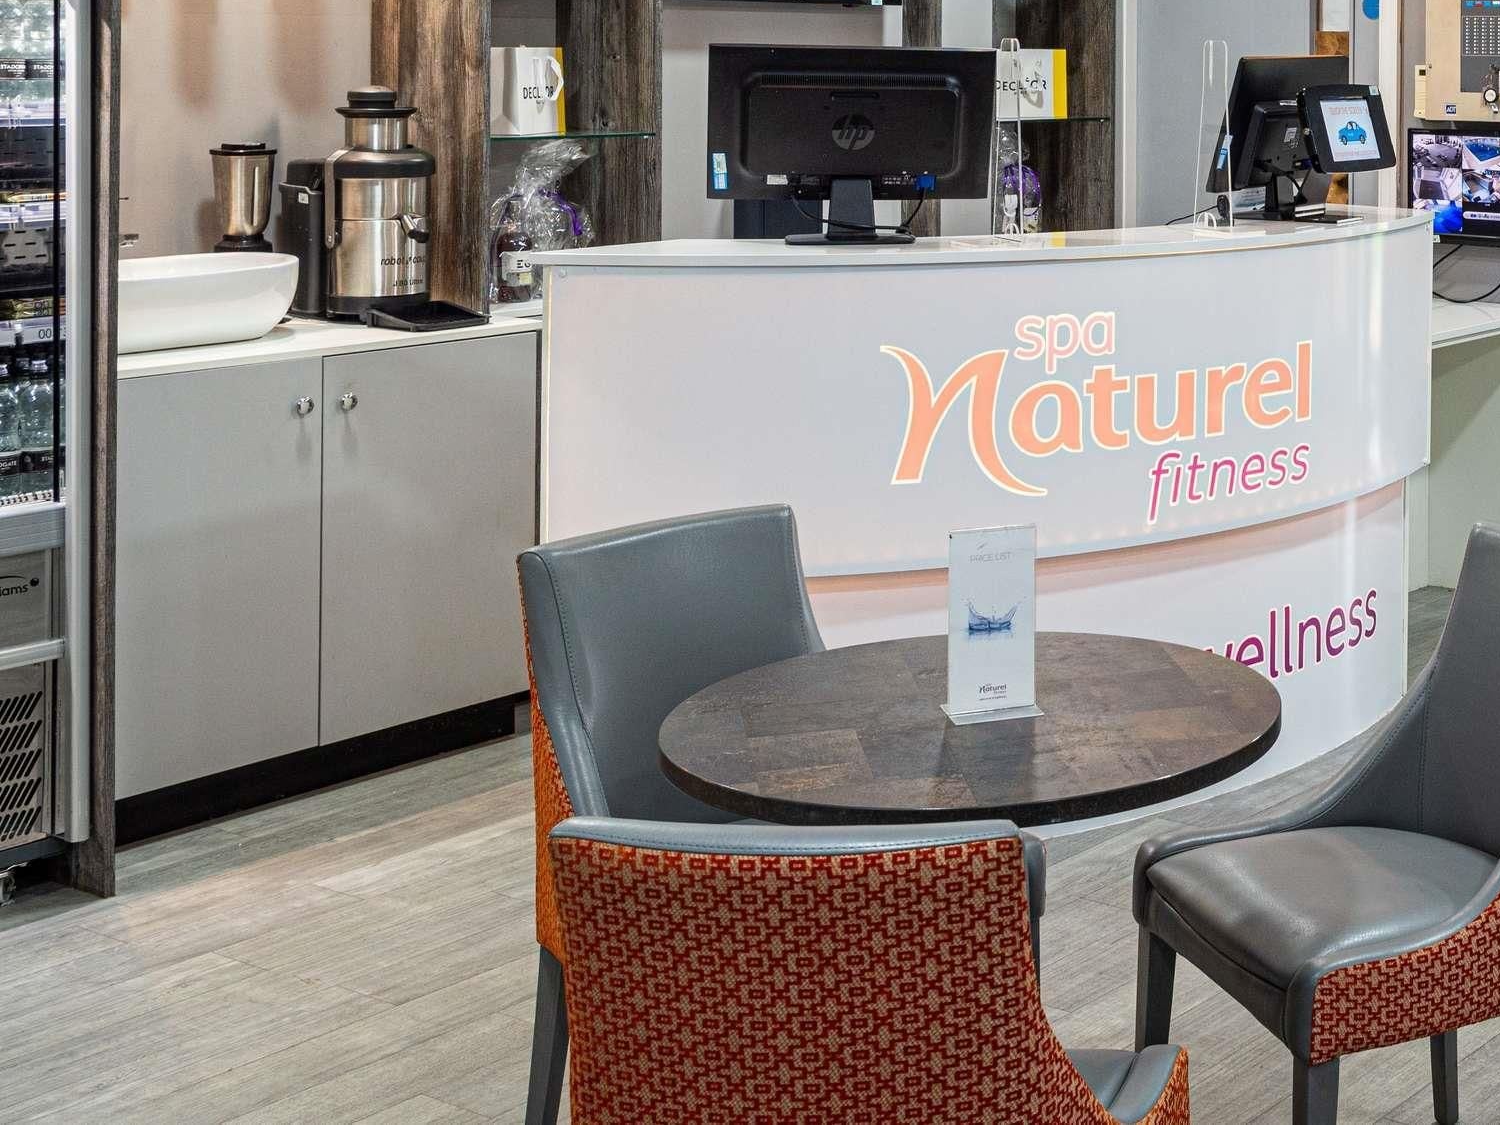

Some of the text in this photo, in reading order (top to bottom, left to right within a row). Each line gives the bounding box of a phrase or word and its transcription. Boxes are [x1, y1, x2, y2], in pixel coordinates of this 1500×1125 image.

[834, 115, 873, 151] hp
[1013, 311, 1115, 372] spa
[880, 339, 1313, 495] Naturel
[1147, 443, 1311, 523] fitness
[969, 552, 993, 563] PRICE
